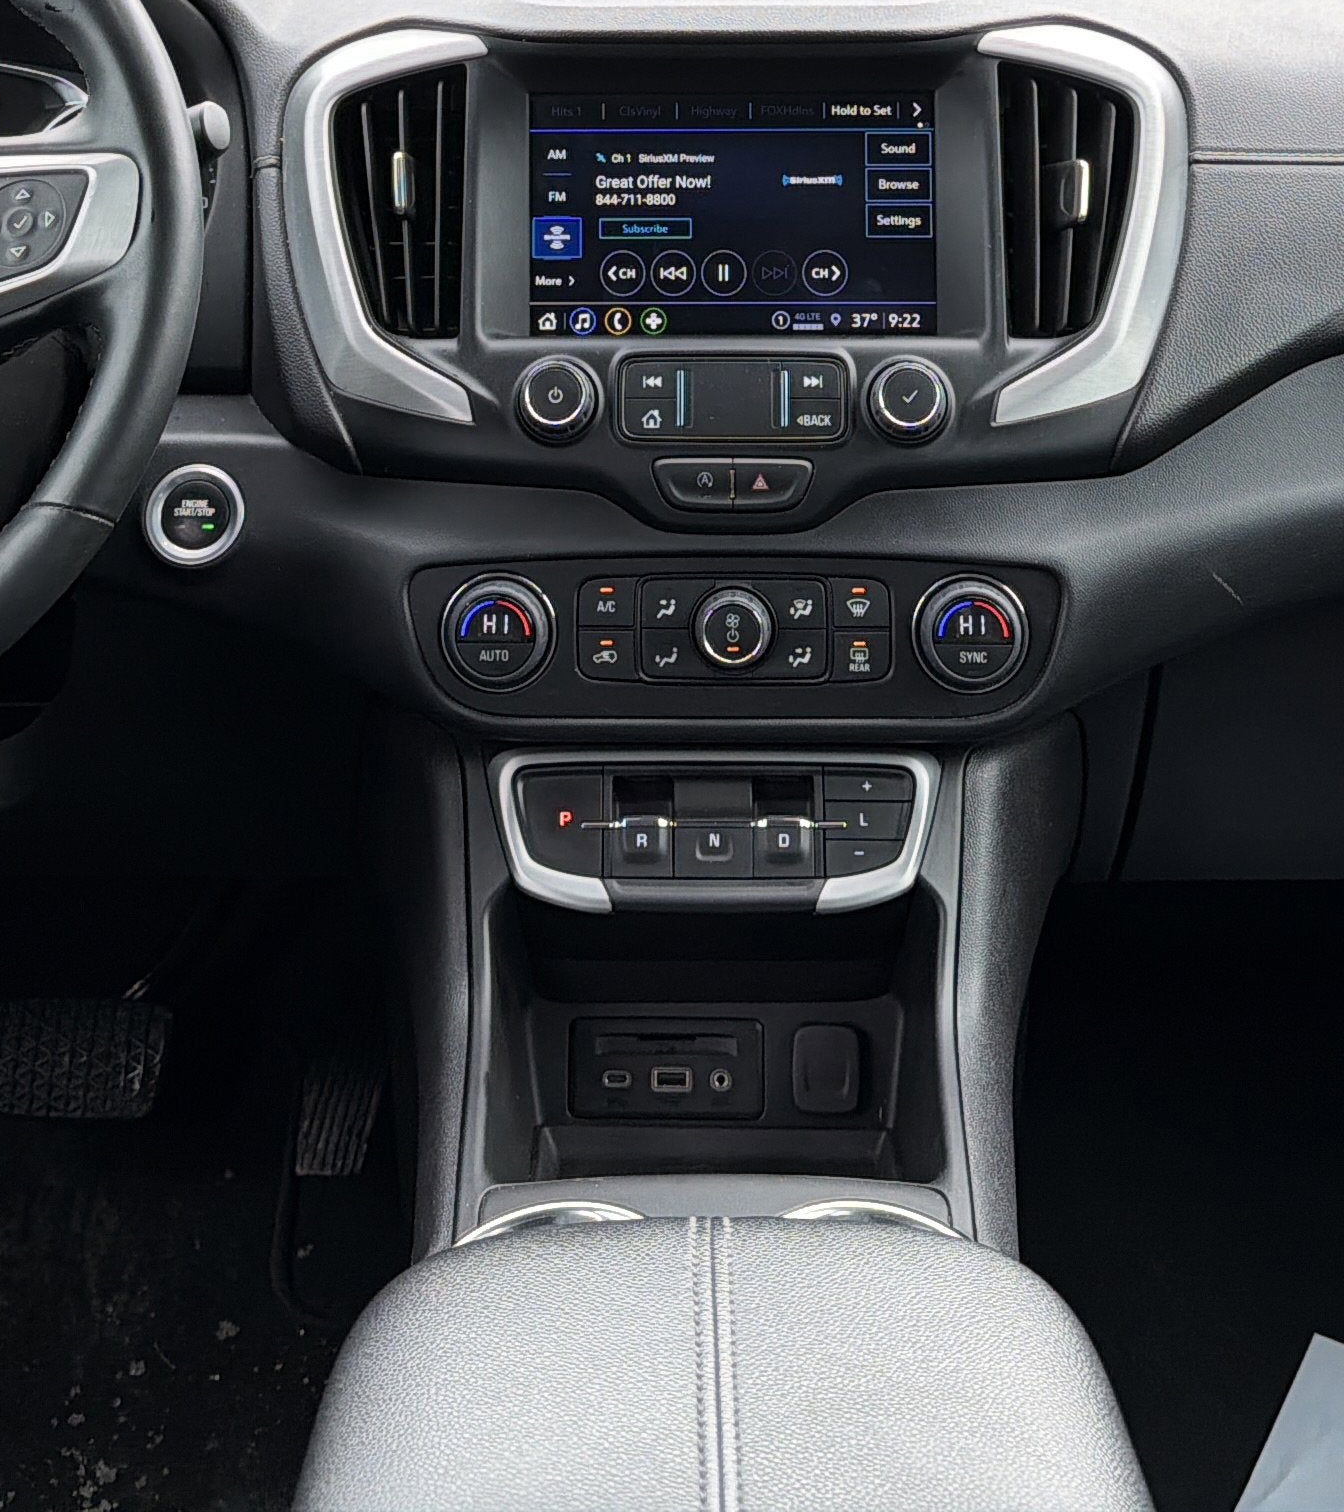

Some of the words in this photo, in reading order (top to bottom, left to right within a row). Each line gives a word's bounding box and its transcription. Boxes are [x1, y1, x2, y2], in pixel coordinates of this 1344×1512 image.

[691, 106, 737, 118] Highway
[831, 104, 857, 116] Hold
[859, 105, 871, 116] to
[873, 104, 892, 116] Set
[547, 149, 567, 160] AM
[881, 143, 916, 154] Sound
[611, 153, 624, 163] Ch
[626, 153, 631, 163] 1
[638, 153, 678, 164] SiriusXM
[680, 153, 715, 163] Preview
[595, 175, 634, 188] Great
[636, 174, 672, 188] Offer
[675, 174, 712, 188] Now!
[878, 178, 919, 190] Browse
[548, 192, 566, 202] FM
[595, 193, 677, 206] 844-711-8800
[876, 214, 922, 228] Settings
[622, 224, 669, 234] Subscribe
[618, 268, 636, 279] CH
[811, 268, 829, 279] CH
[535, 275, 562, 286] More
[807, 313, 821, 321] LTE
[850, 313, 878, 328] 37°
[888, 313, 921, 328] 9:22
[803, 414, 831, 427] BACK
[181, 499, 209, 508] ENGINE
[173, 507, 216, 517] START/STOP
[596, 600, 615, 614] A/C
[483, 618, 509, 634] HI
[959, 615, 987, 634] HI
[479, 649, 509, 662] AUTO
[958, 650, 988, 665] SYNC
[849, 662, 871, 673] REAR
[559, 811, 572, 827] P
[859, 812, 869, 827] L
[636, 832, 648, 848] R
[708, 832, 721, 848] N
[778, 832, 790, 848] D
